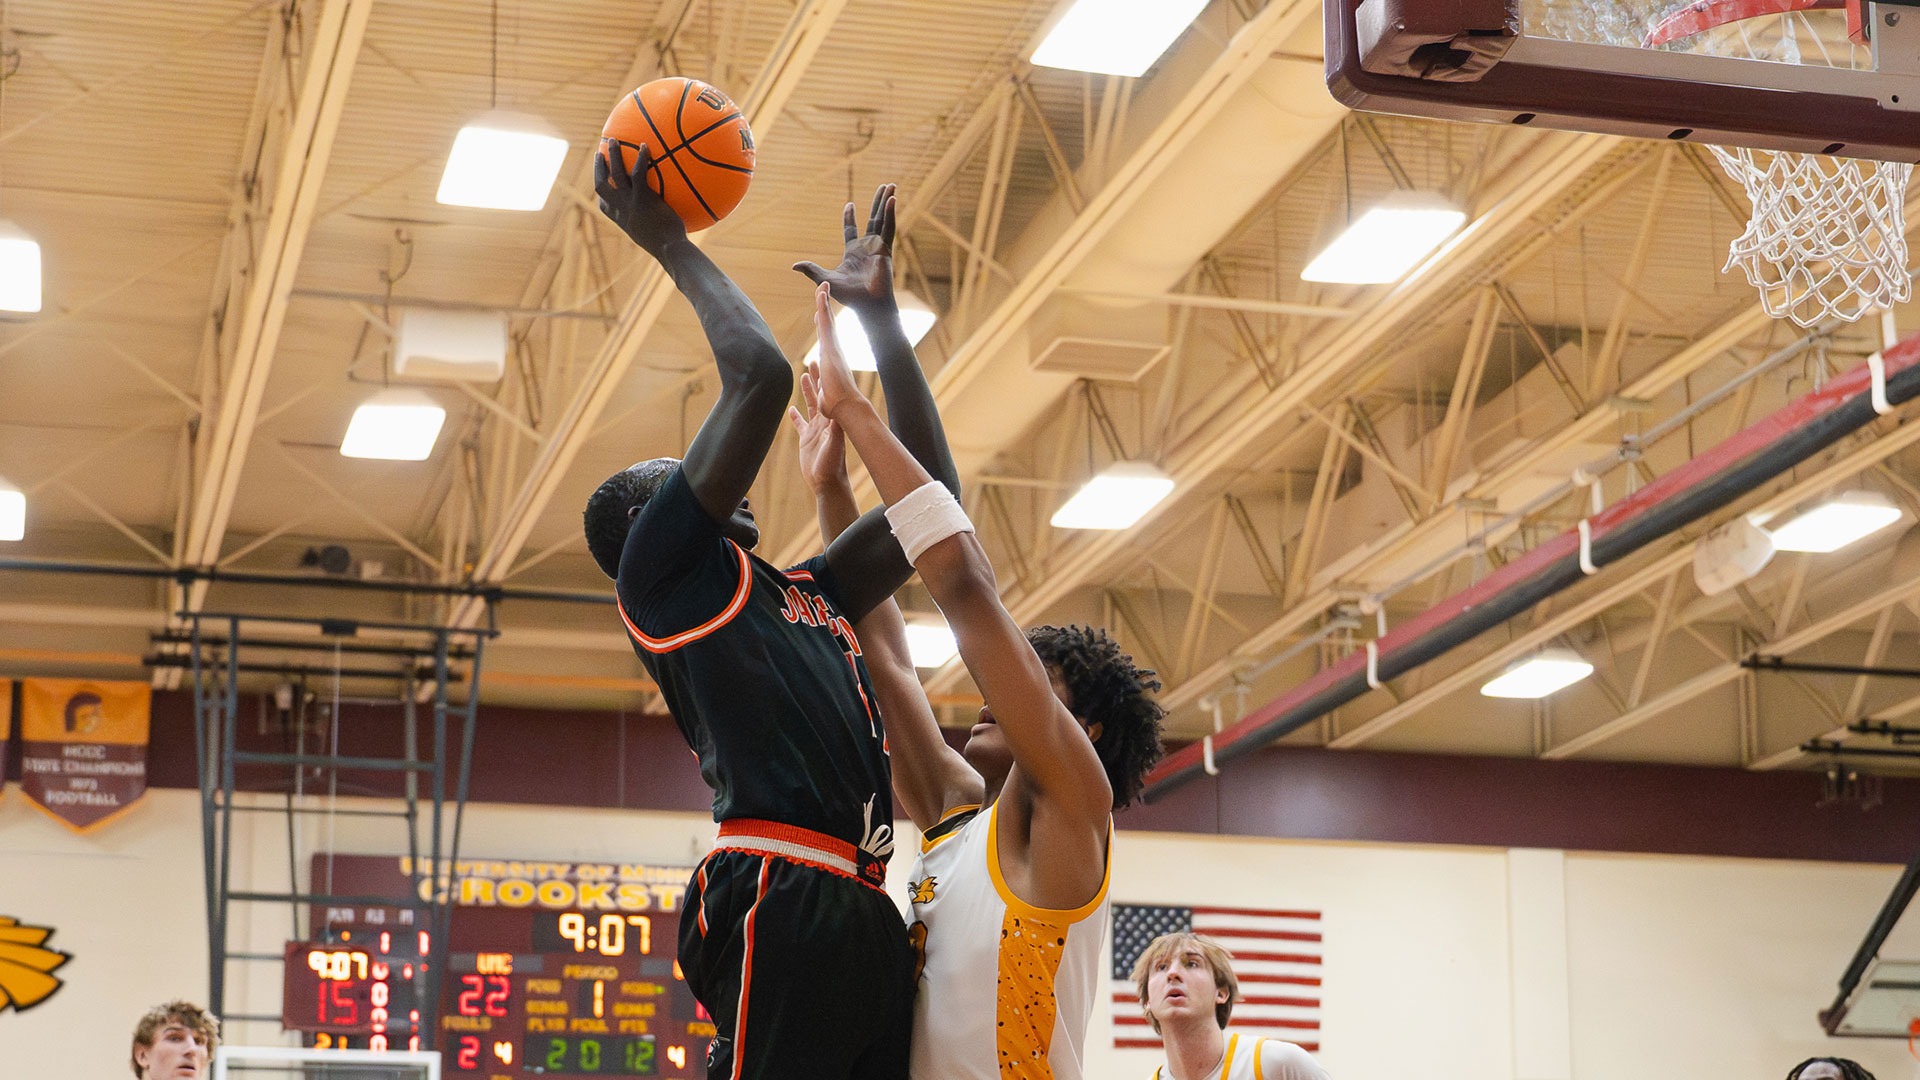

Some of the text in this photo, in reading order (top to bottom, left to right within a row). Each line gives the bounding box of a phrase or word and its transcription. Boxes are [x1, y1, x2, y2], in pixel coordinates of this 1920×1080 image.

[44, 790, 119, 806] FOOTBALL
[576, 864, 615, 881] OF
[558, 912, 651, 956] 9:07
[308, 951, 368, 981] 9:07
[476, 952, 513, 975] UMC
[318, 980, 358, 1025] 15
[458, 974, 511, 1017] 22
[593, 980, 605, 1019] 1
[458, 1036, 480, 1069] 2
[493, 1041, 513, 1065] 4
[667, 1045, 686, 1069] 4
